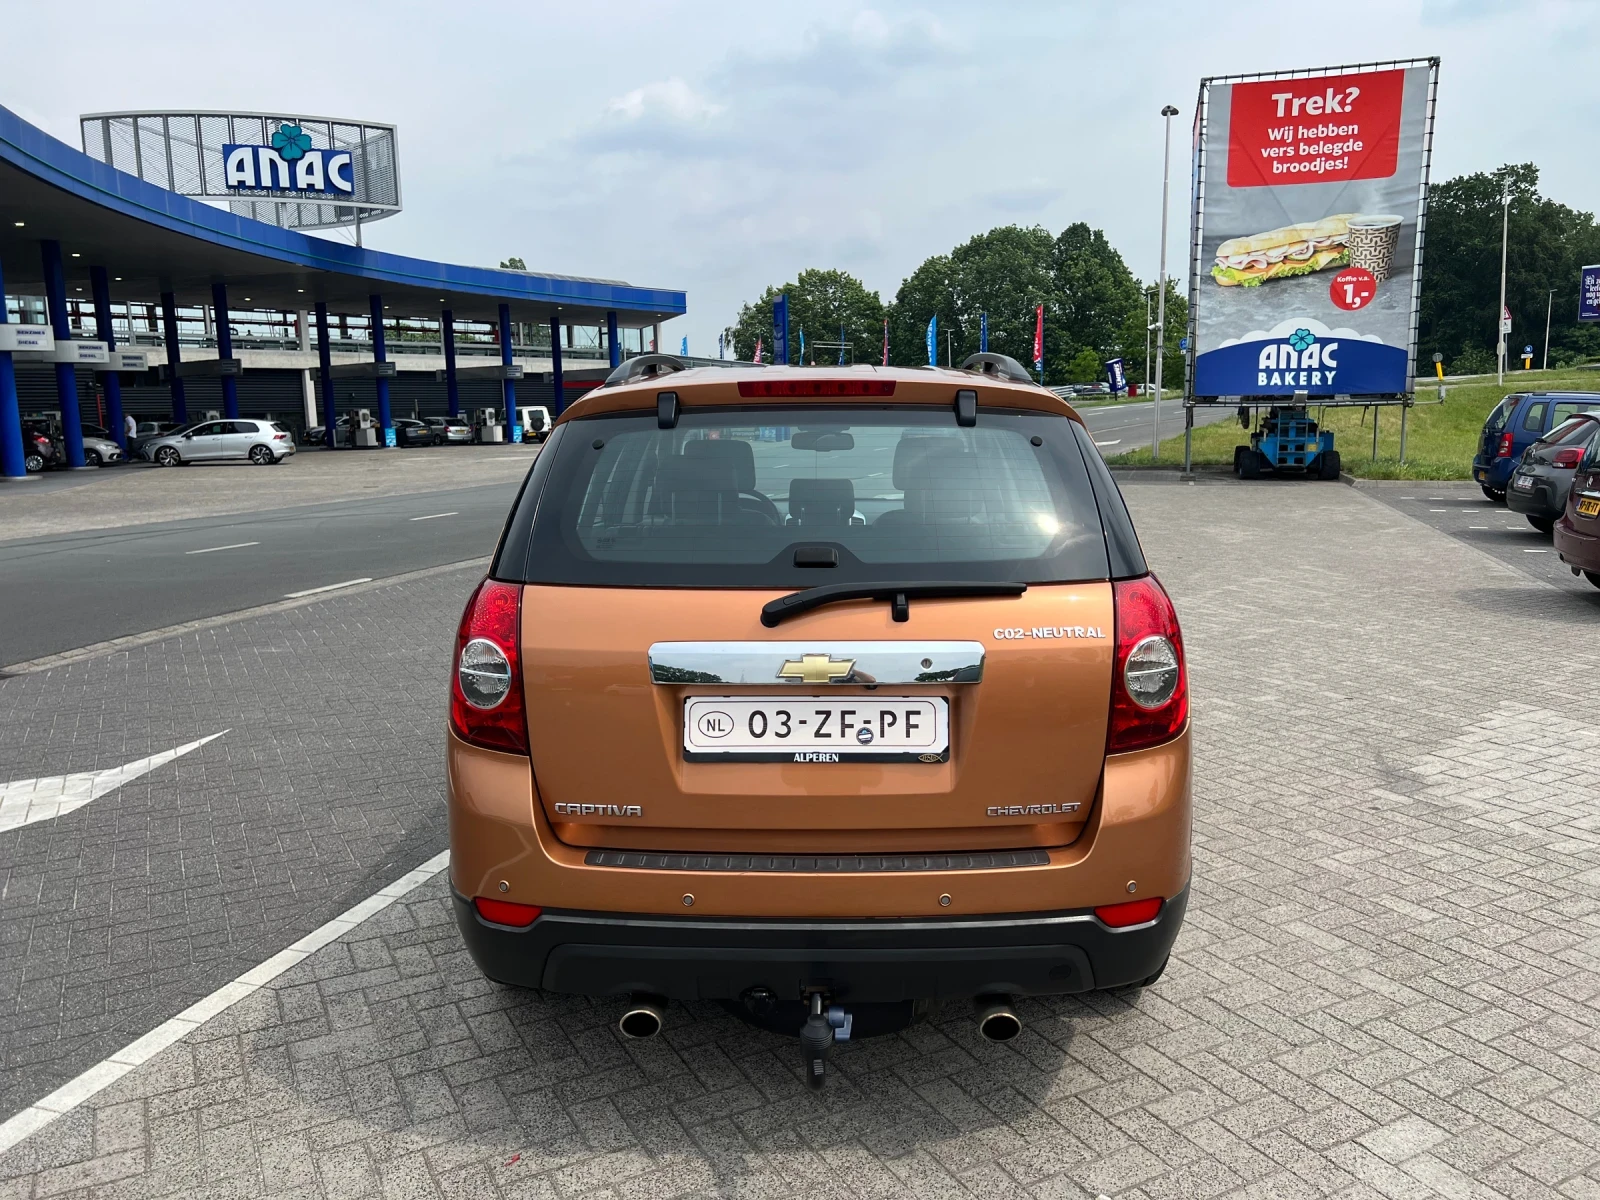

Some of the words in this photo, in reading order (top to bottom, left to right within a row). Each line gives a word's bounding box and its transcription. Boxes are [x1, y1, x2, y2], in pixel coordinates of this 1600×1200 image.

[1272, 87, 1360, 118] Trek?
[1268, 126, 1294, 143] Wij
[1298, 123, 1359, 139] hebben
[1261, 146, 1295, 158] vers
[1299, 139, 1363, 156] belegde
[226, 147, 353, 193] ANAC
[1272, 157, 1349, 174] broodjes!
[1343, 284, 1369, 308] 1,-
[1258, 342, 1338, 370] ANAC
[1258, 371, 1337, 386] BAKERY
[706, 718, 726, 733] NL
[748, 709, 922, 739] 03-ZF-PF
[793, 752, 839, 763] ALPEREN
[554, 802, 642, 817] CAPTIVA
[987, 802, 1081, 816] CHEVROLET
